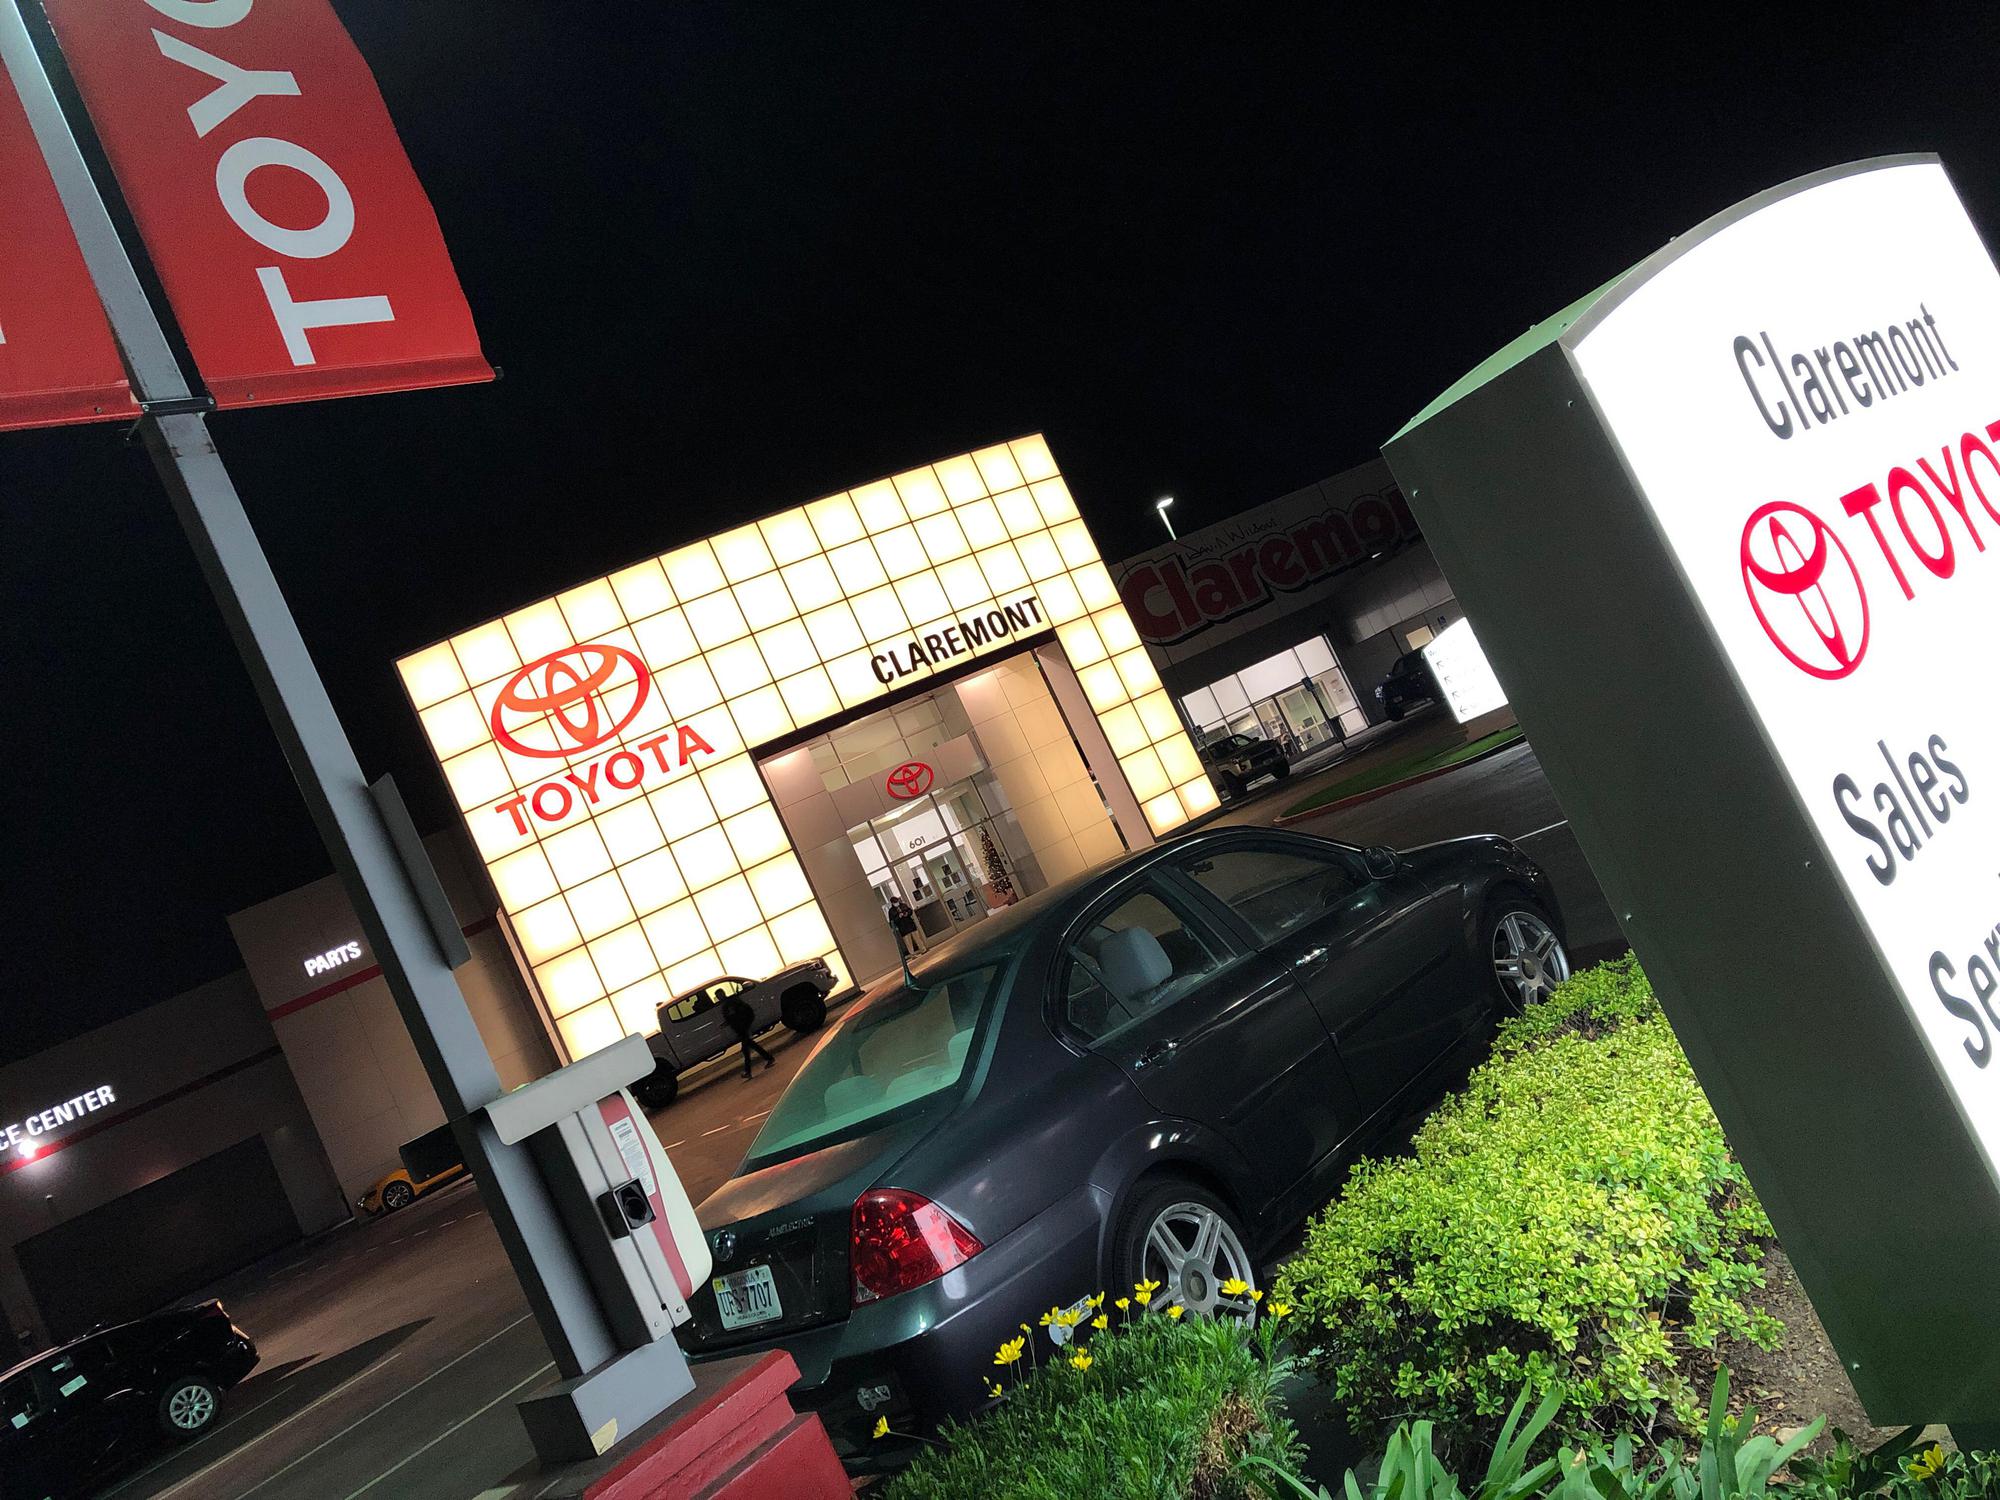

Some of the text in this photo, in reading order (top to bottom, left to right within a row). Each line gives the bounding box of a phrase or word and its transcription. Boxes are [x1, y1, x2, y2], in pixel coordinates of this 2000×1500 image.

[146, 0, 395, 366] TOY
[1733, 302, 1959, 440] Claremont
[870, 596, 1043, 684] CLAREMONT
[494, 724, 716, 836] TOYOTA
[1832, 734, 1970, 887] Sales
[909, 836, 926, 849] 601
[303, 941, 362, 977] PARTS
[25, 1085, 116, 1136] CENTER
